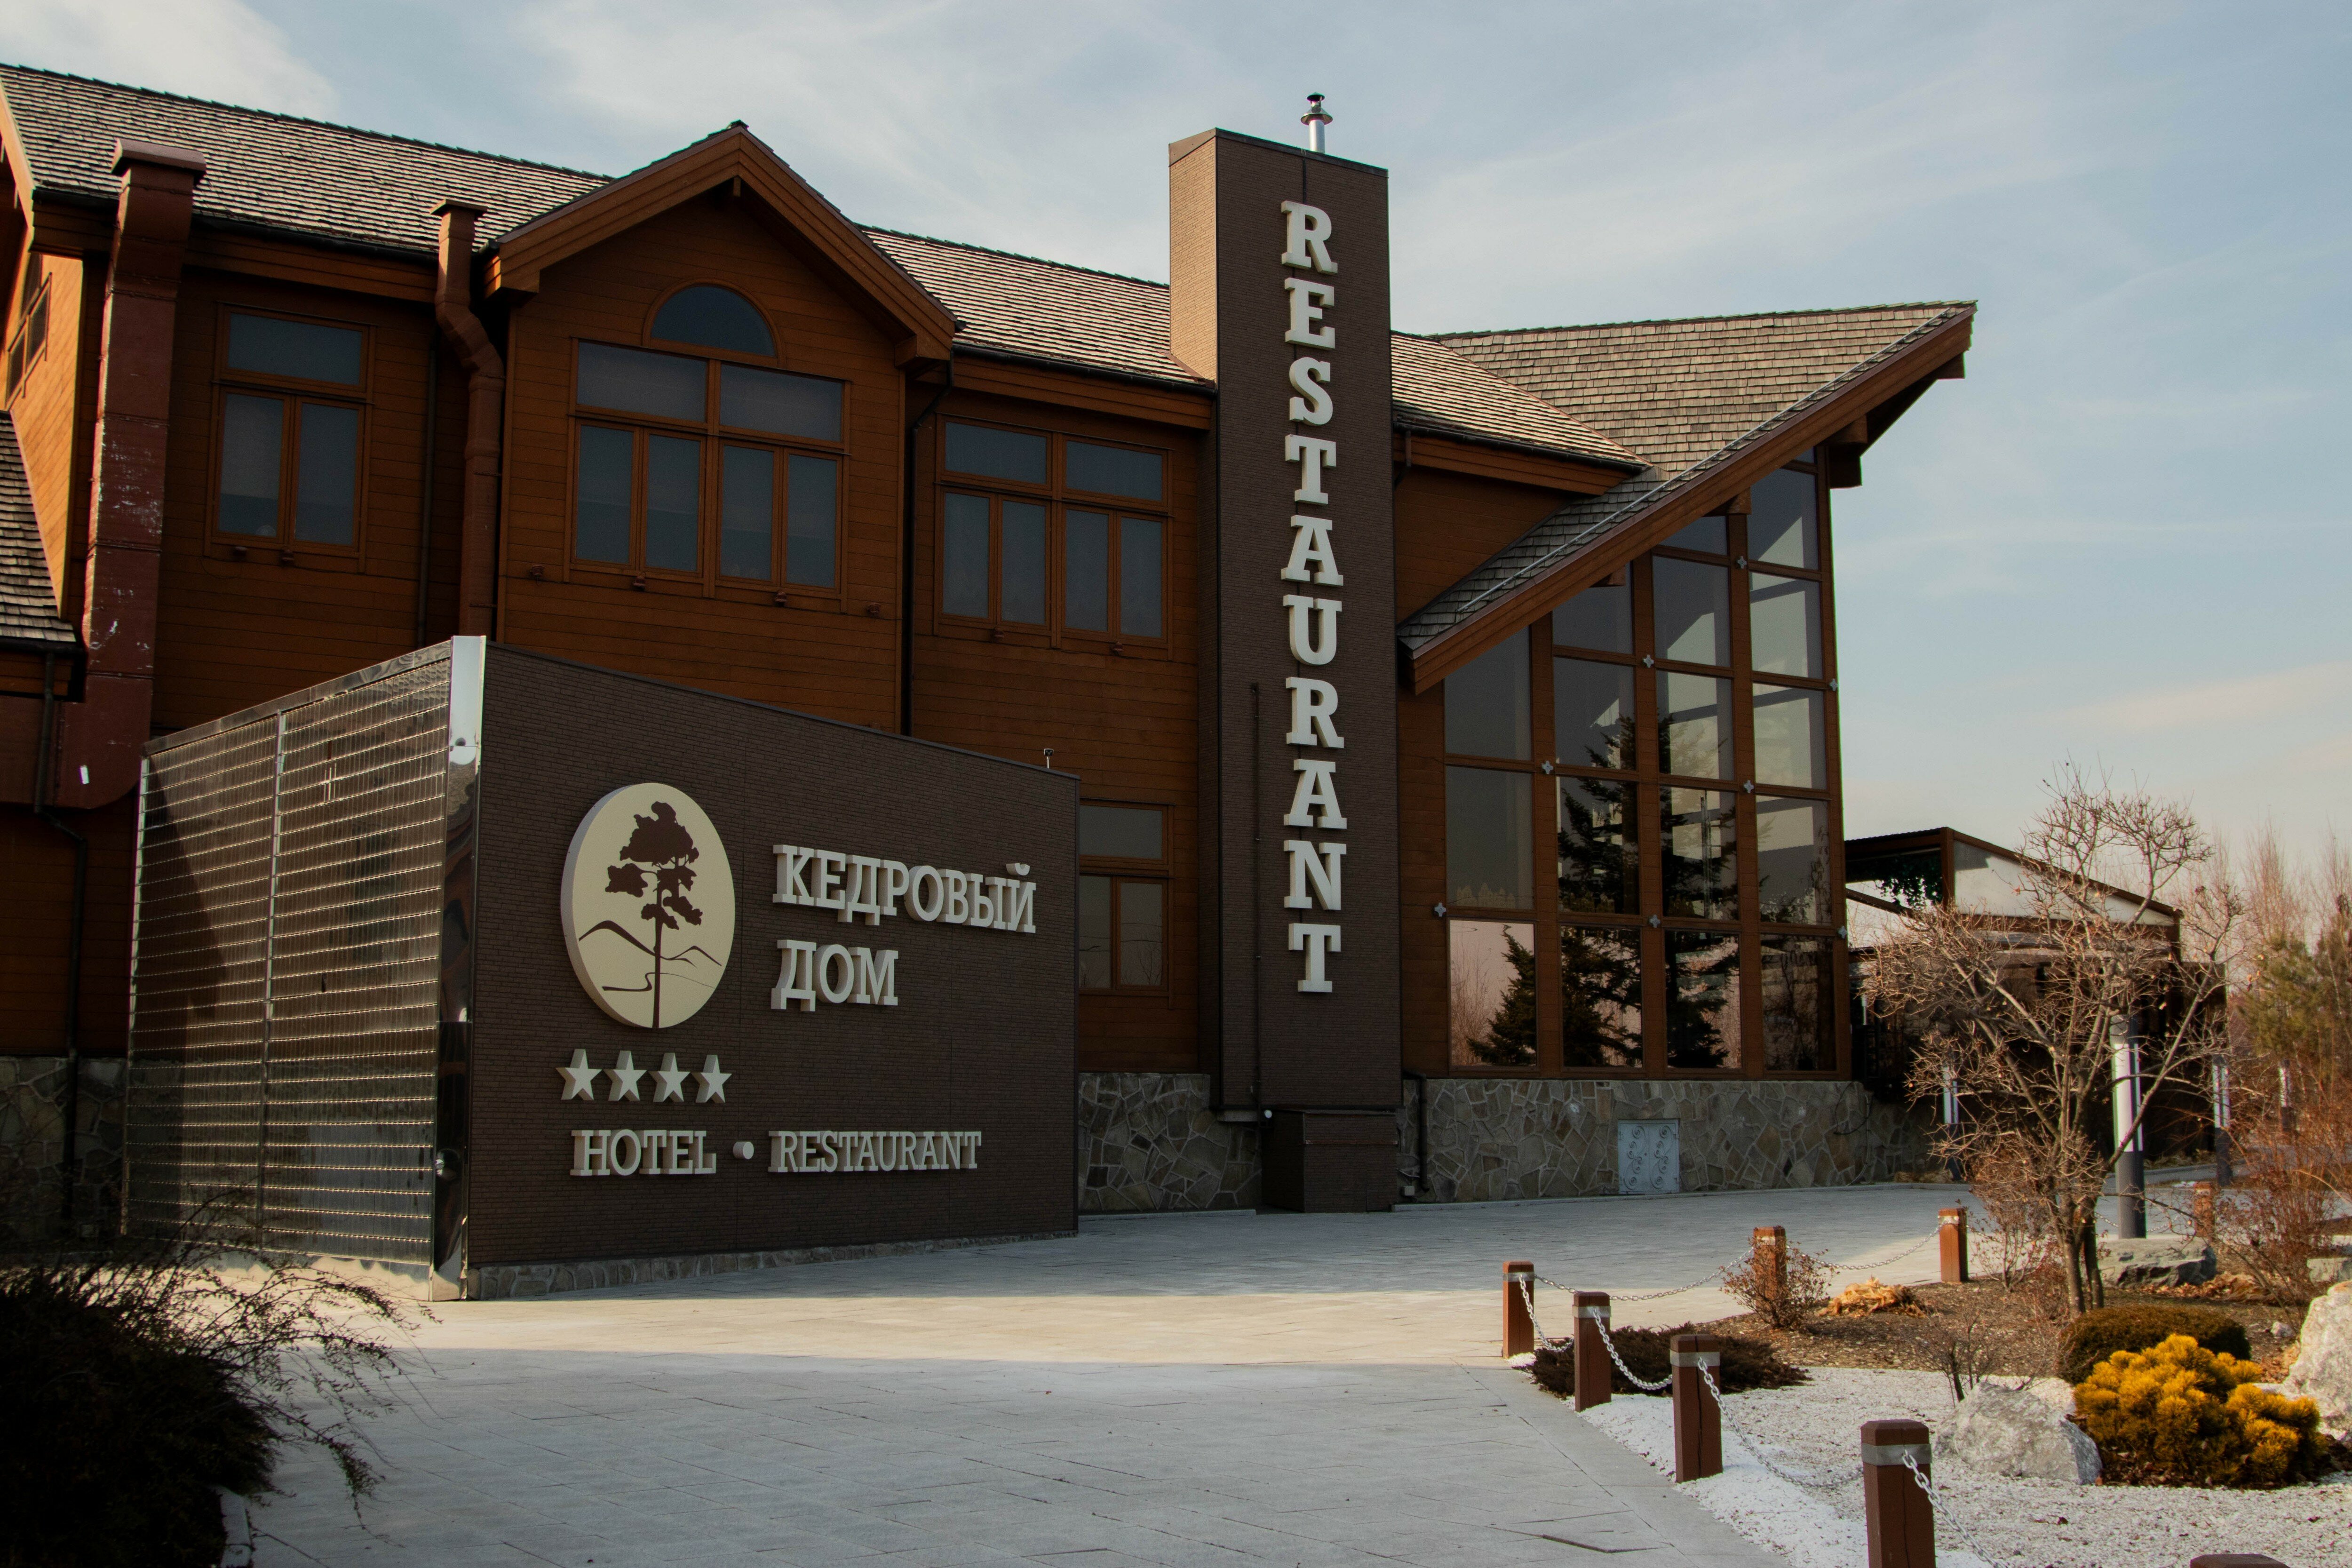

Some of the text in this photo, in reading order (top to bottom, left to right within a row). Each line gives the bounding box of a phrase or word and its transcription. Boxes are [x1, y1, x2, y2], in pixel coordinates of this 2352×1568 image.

[1281, 200, 1347, 993] RESTAURANT
[773, 844, 1036, 933] КЕДРОВЫЙ
[771, 939, 898, 1011] ДОМ
[570, 1129, 982, 1176] HOTEL RESTAURANT
